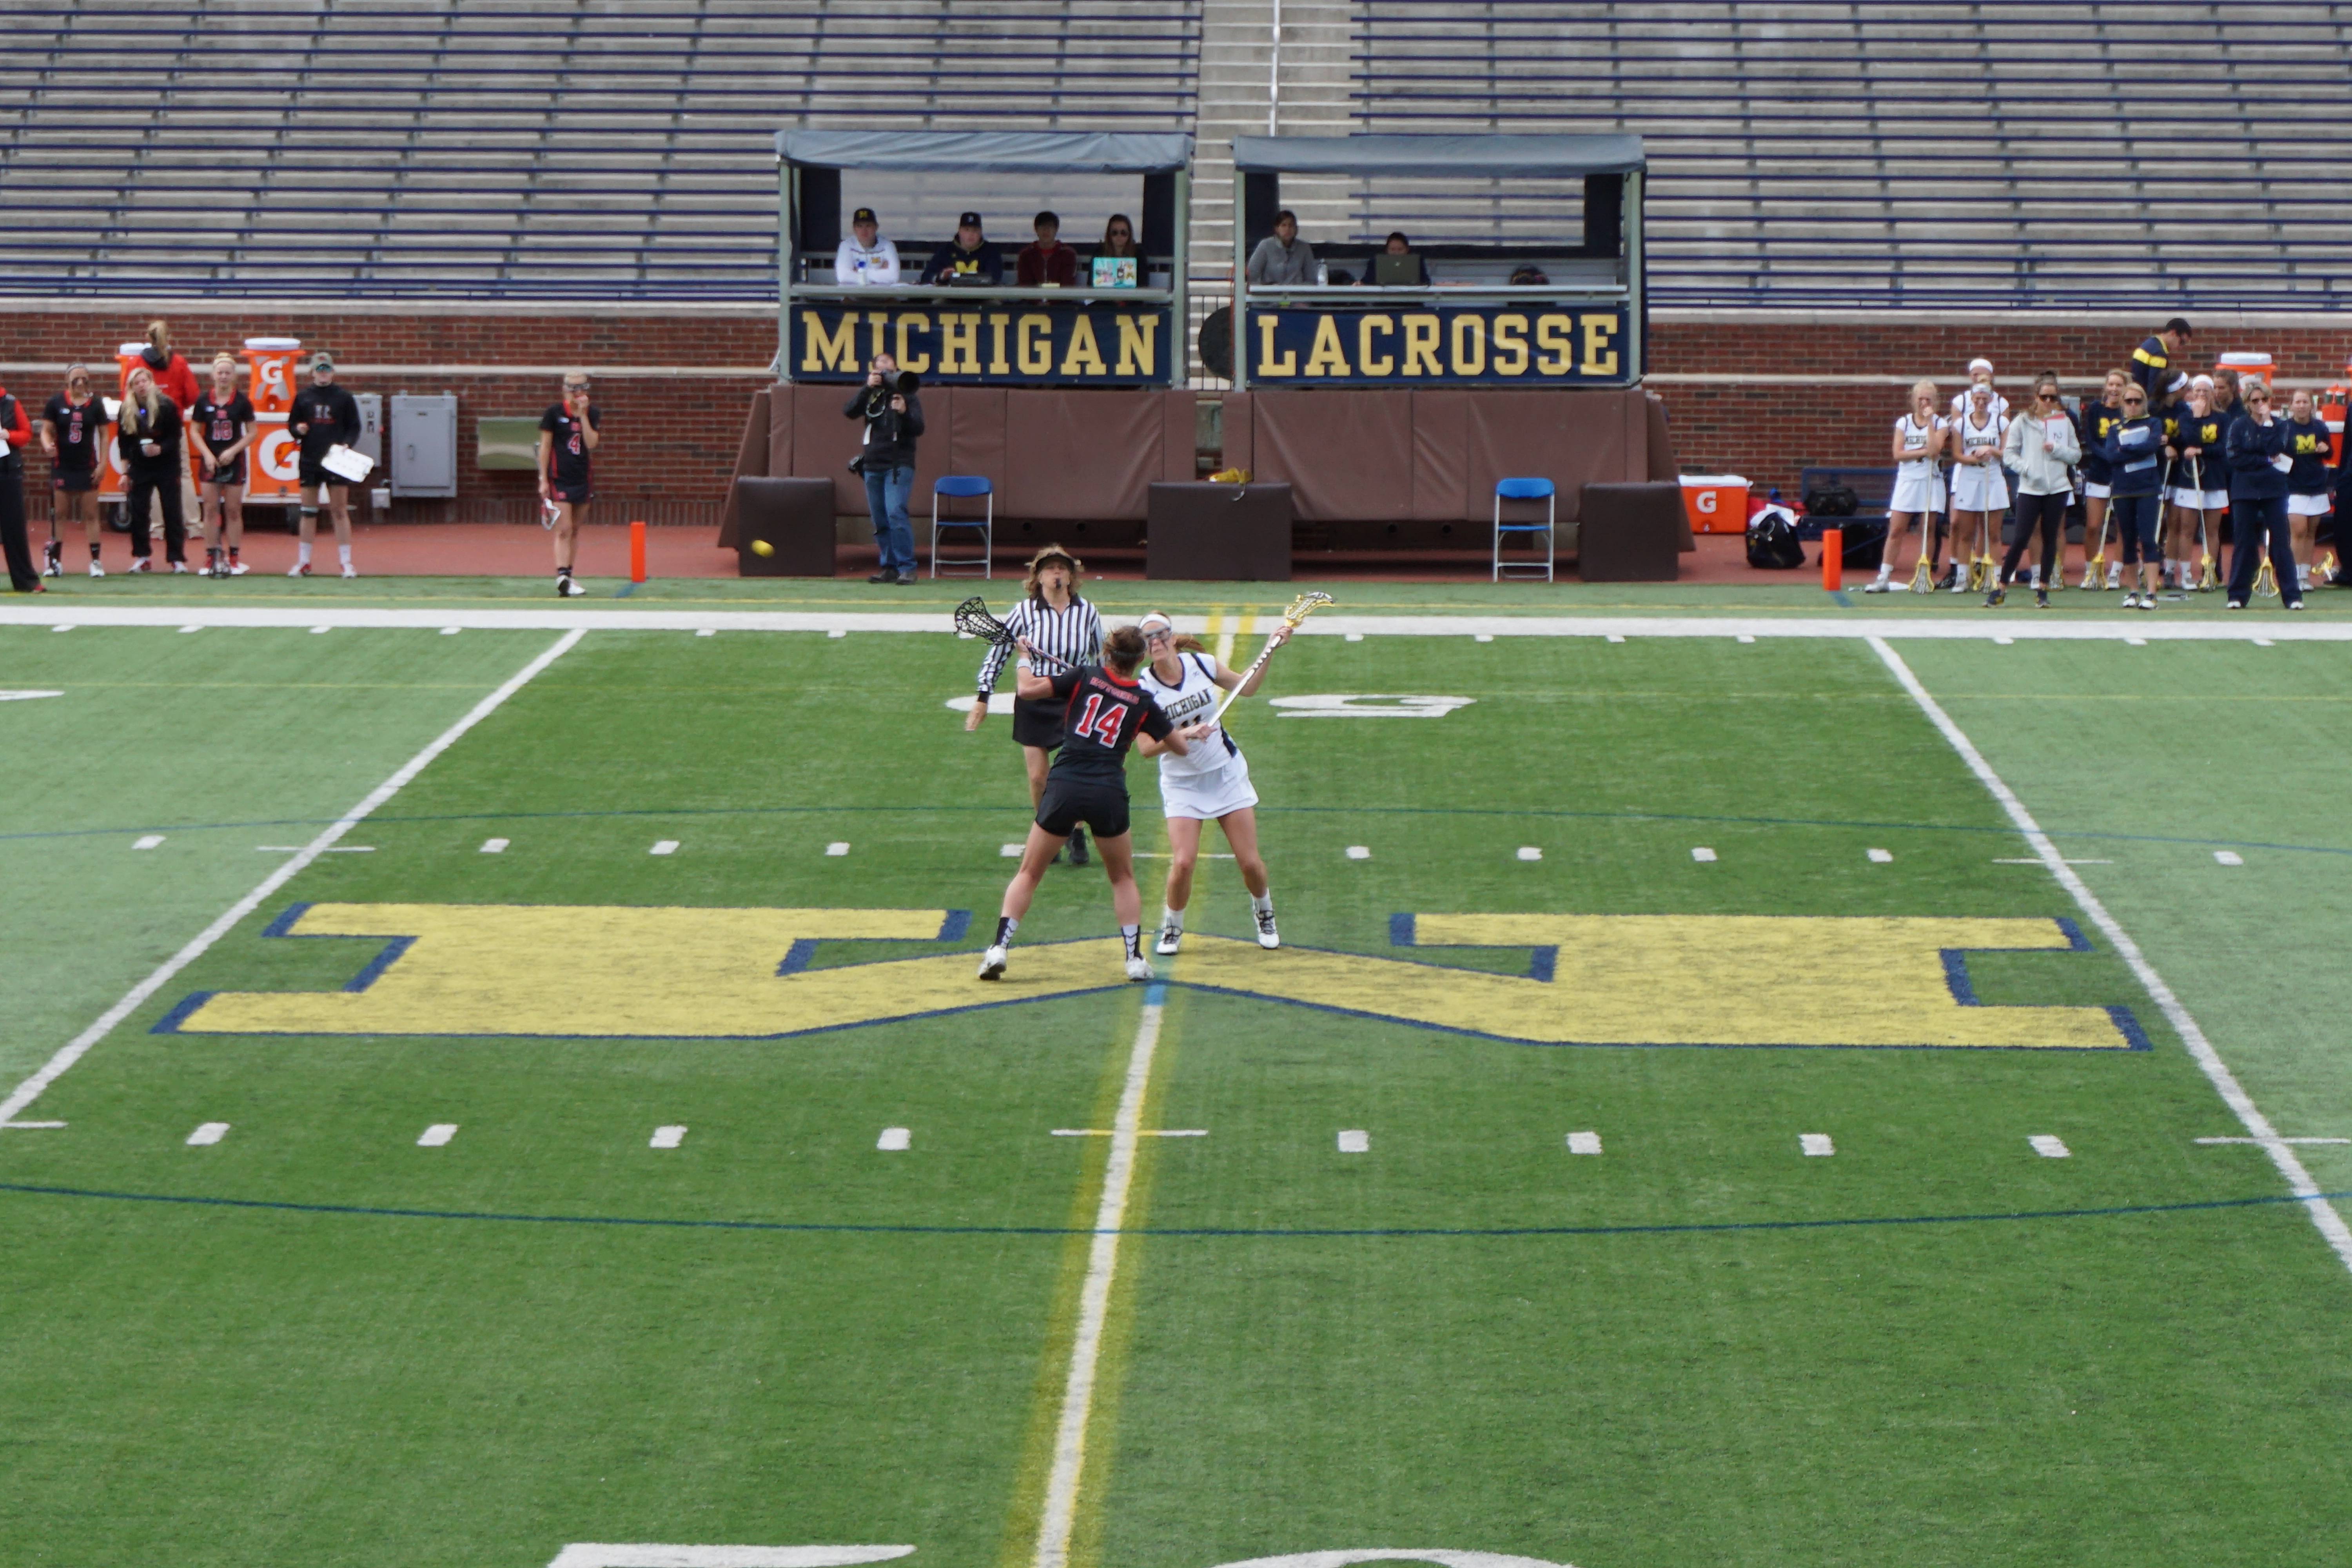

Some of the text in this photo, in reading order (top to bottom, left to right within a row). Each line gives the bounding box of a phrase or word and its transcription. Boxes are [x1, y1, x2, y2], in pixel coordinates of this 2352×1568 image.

[802, 311, 1158, 376] MICHIGAN
[1258, 314, 1618, 376] LACROSSE
[261, 359, 283, 385] G
[69, 422, 83, 443] 5
[2201, 423, 2217, 440] M
[2296, 434, 2316, 450] M
[259, 429, 300, 481] G
[567, 433, 581, 455] 4
[1696, 491, 1717, 513] G
[1074, 693, 1129, 749] 14
